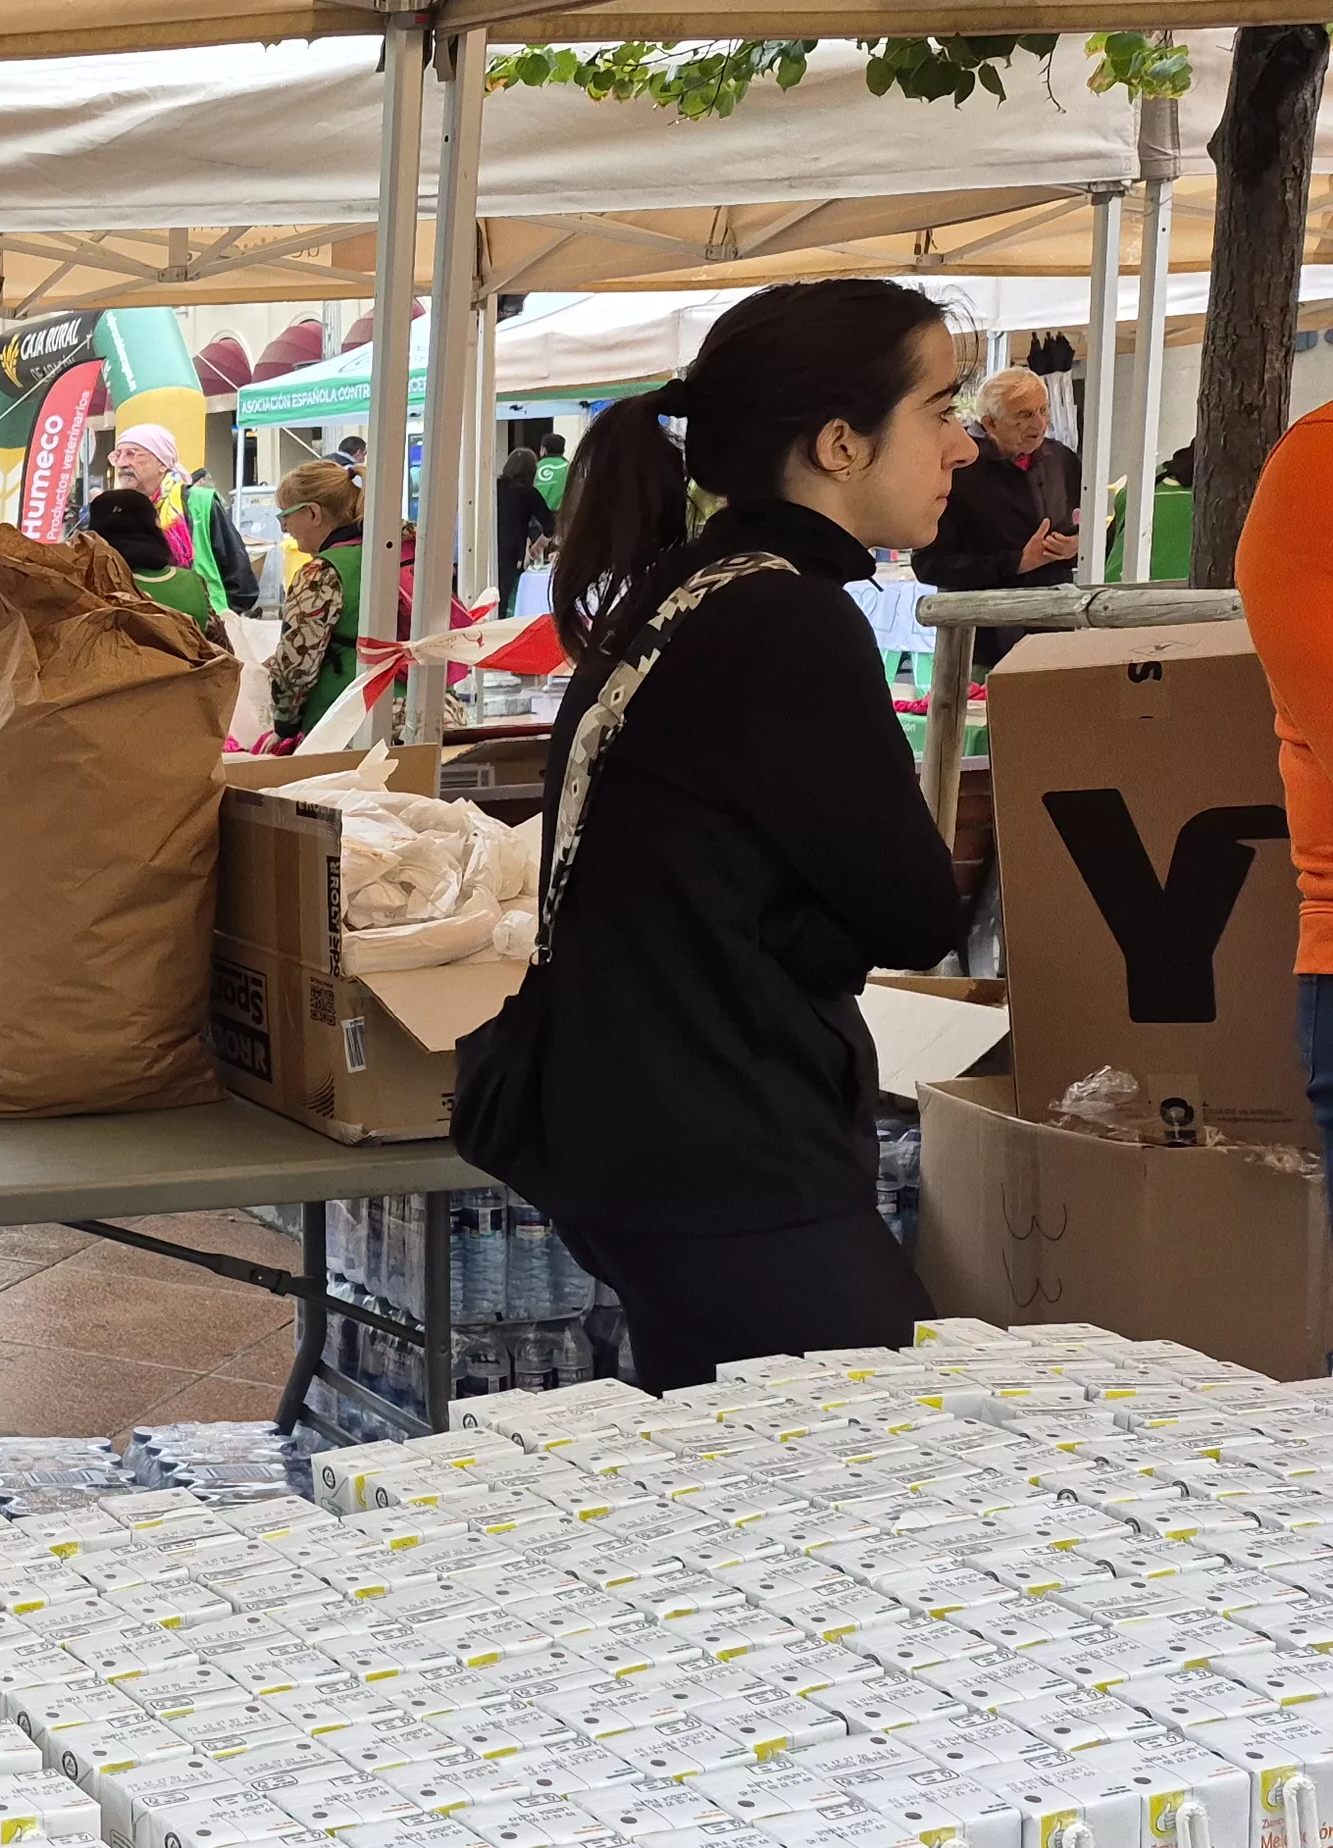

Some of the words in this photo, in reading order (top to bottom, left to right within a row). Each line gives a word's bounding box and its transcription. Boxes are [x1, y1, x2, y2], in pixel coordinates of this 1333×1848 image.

[20, 332, 48, 360] CAJA
[45, 317, 82, 354] RURAL
[23, 415, 64, 540] Humeco
[46, 472, 70, 541] Productos
[62, 391, 91, 470] veterinarios
